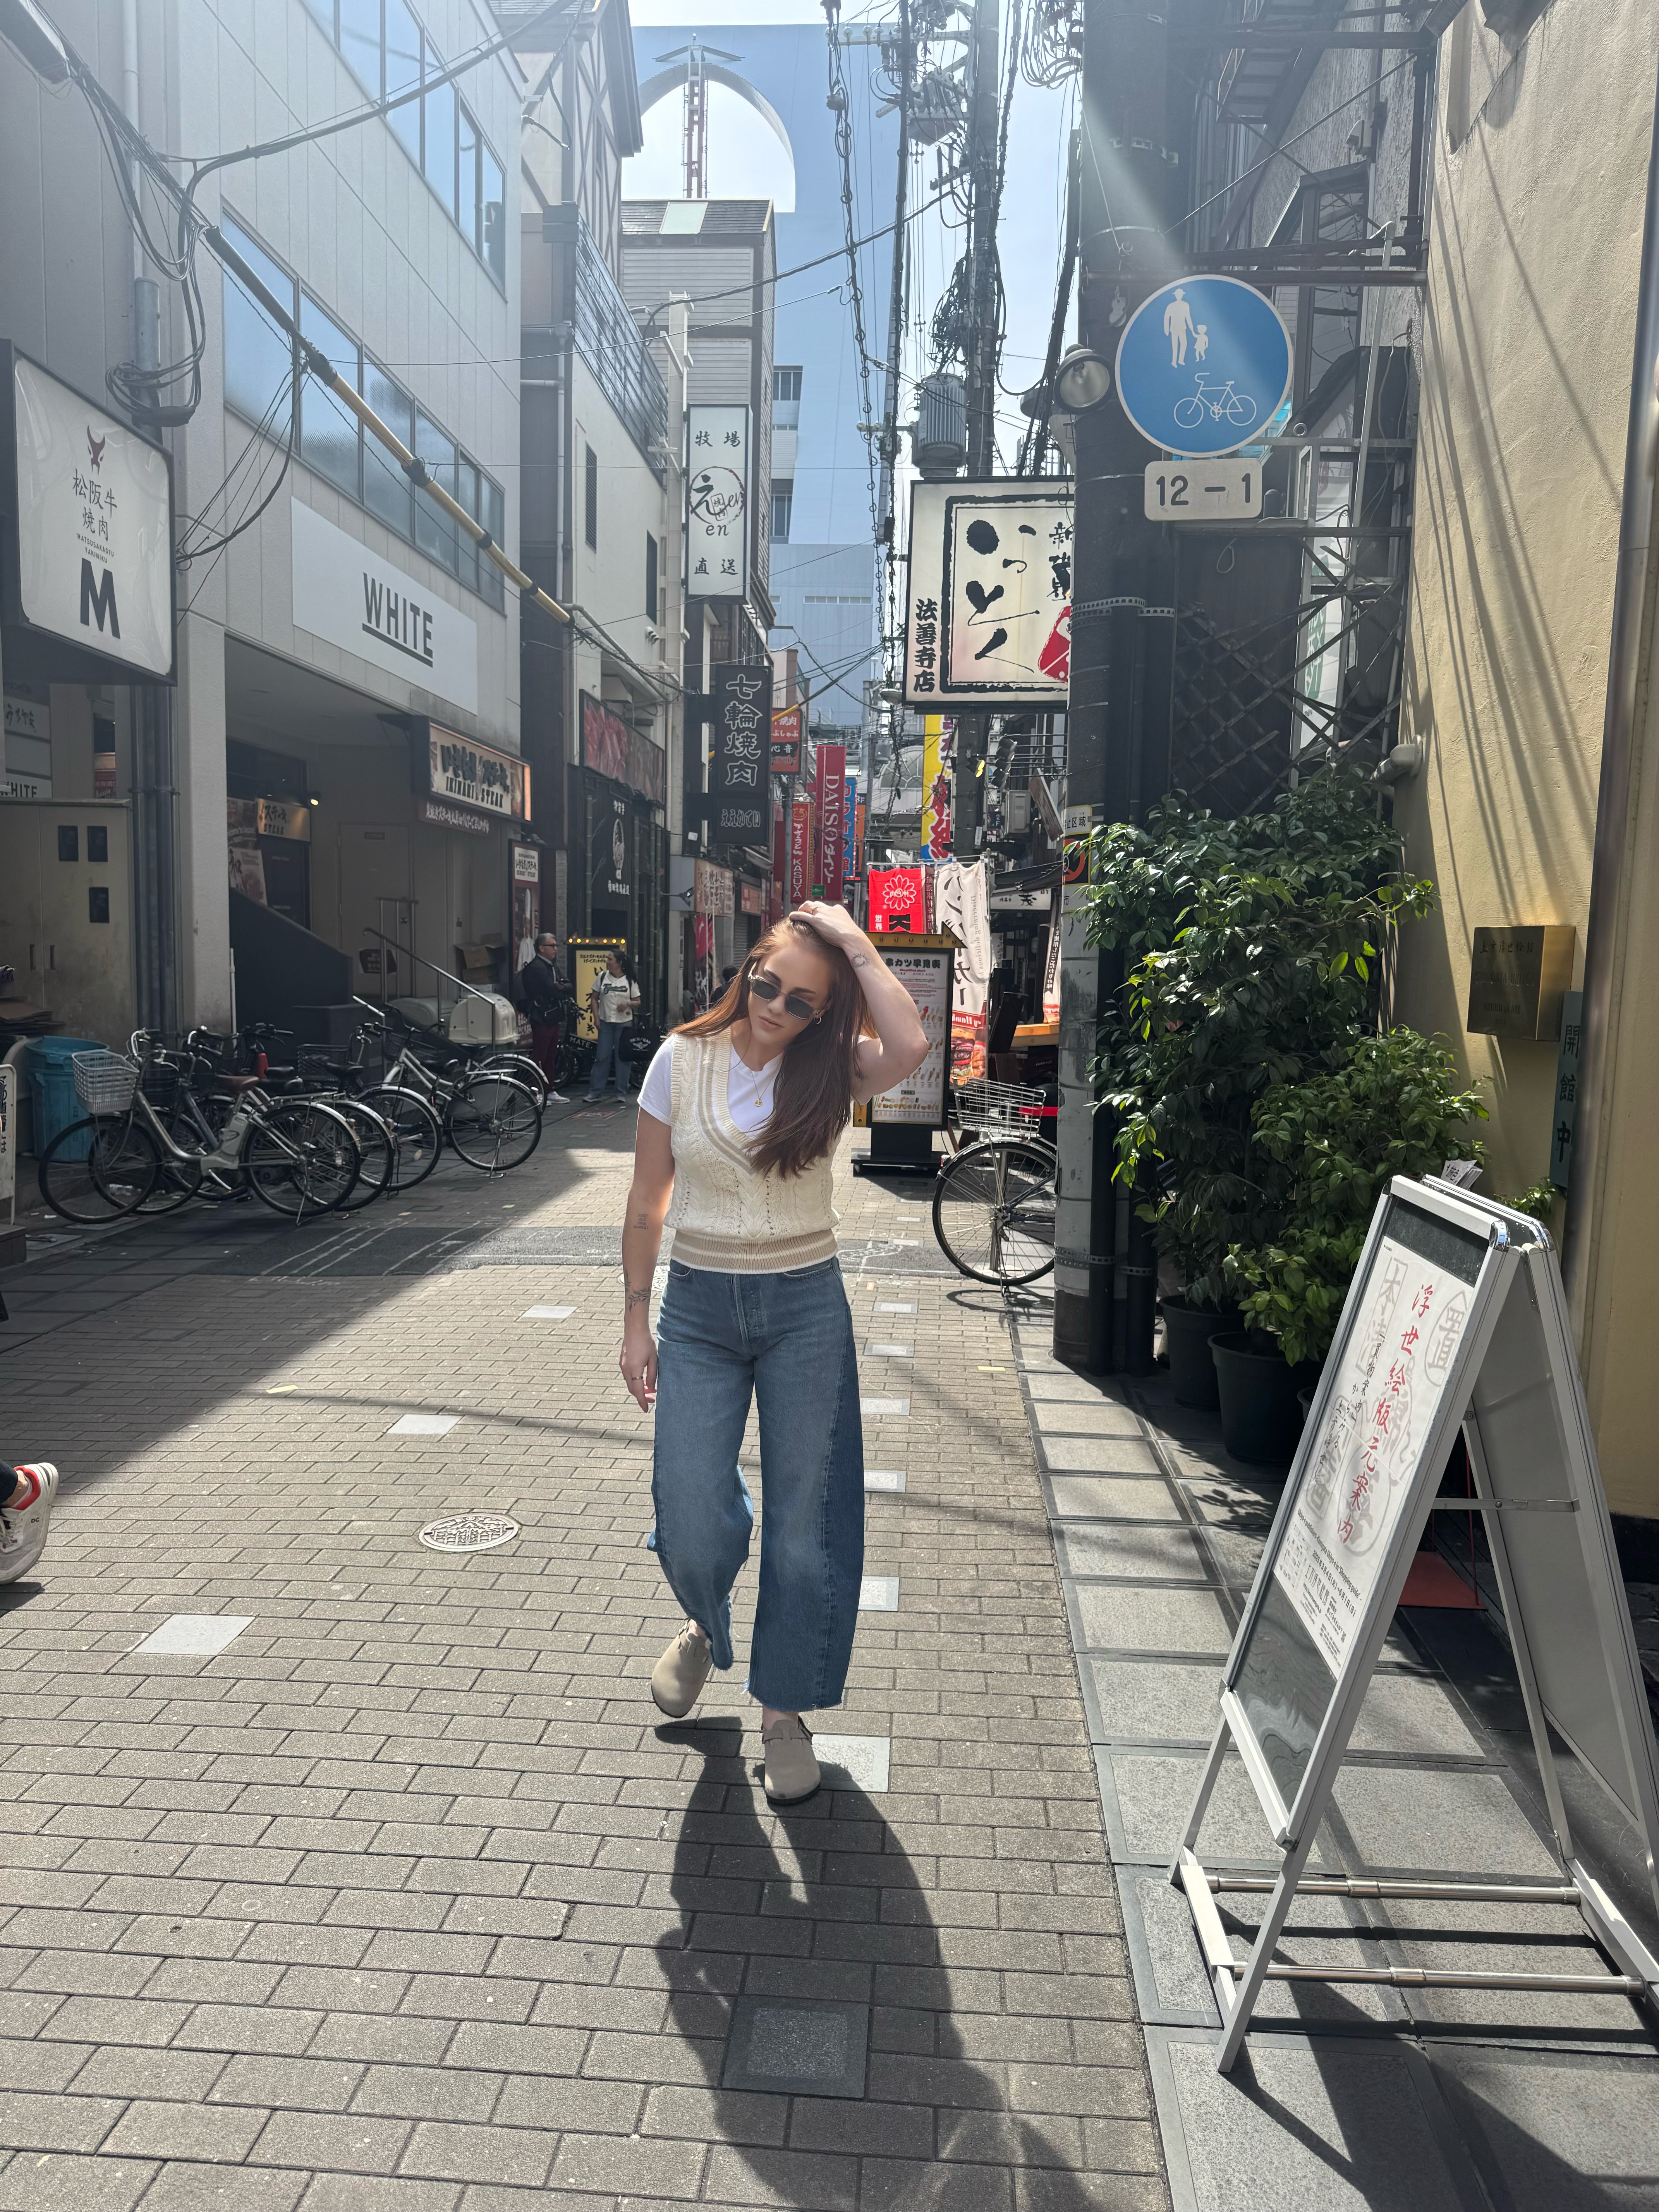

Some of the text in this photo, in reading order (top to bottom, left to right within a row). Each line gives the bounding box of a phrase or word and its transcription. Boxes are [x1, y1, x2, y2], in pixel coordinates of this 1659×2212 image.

[695, 431, 741, 448] 牧場
[72, 468, 118, 519] 松阪牛
[82, 507, 109, 542] 焼肉
[706, 524, 729, 536] en
[77, 533, 115, 558] MATSUSAKAGYU
[85, 547, 108, 563] YAKINIKU
[694, 557, 739, 575] 直送
[81, 557, 120, 640] M
[363, 572, 433, 659] WHITE
[913, 598, 938, 693] 法善寺店
[724, 674, 763, 787] 七輪焼肉
[775, 716, 797, 726] 焼肉
[771, 744, 793, 753] 心音
[446, 776, 503, 808] IKINARI STEAK
[824, 775, 840, 842] DAISO
[1064, 816, 1086, 830] 止区域
[793, 859, 803, 898] KASUYA
[824, 844, 836, 884] ダイソー
[1557, 1024, 1581, 1163] 開館中
[1337, 1284, 1433, 1544] 浮世絵版元案内
